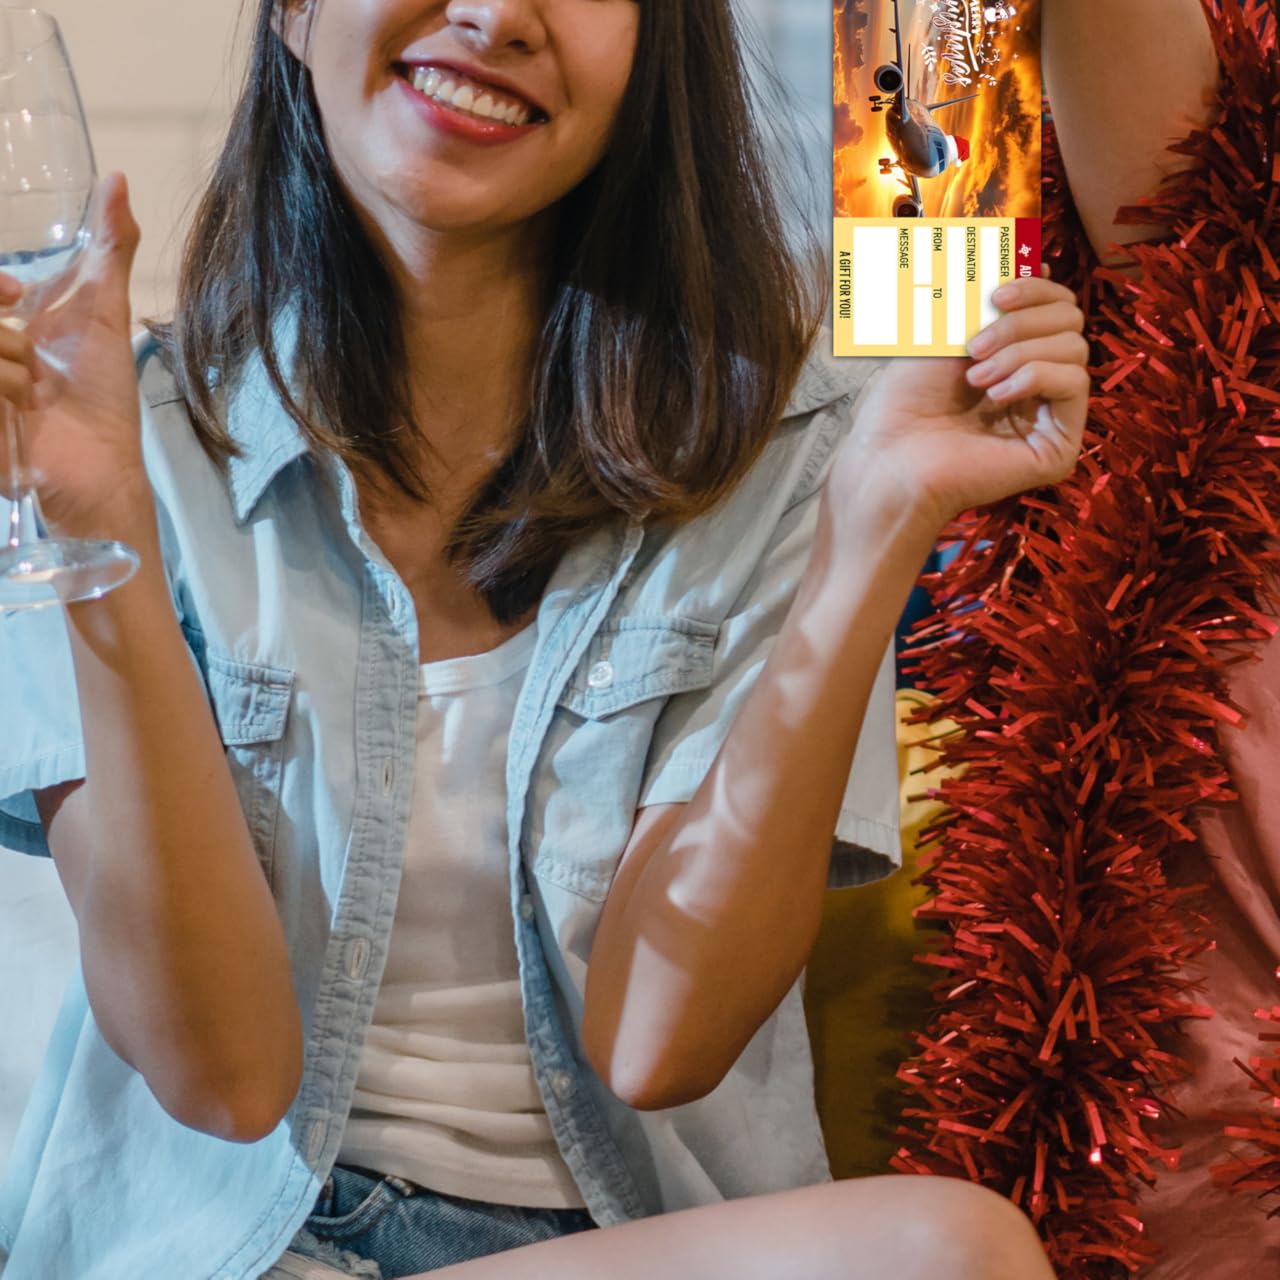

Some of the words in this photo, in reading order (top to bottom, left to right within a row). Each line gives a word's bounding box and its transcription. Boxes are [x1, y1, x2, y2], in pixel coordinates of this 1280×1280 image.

[900, 227, 909, 269] MESSAGE
[933, 227, 943, 252] FROM
[967, 226, 976, 282] DESTINATION
[1000, 226, 1010, 278] PASSENGER
[839, 258, 851, 278] GIFT
[1019, 264, 1032, 278] AD
[839, 279, 851, 297] FOR
[933, 287, 943, 299] TO
[839, 298, 851, 319] YOU!
